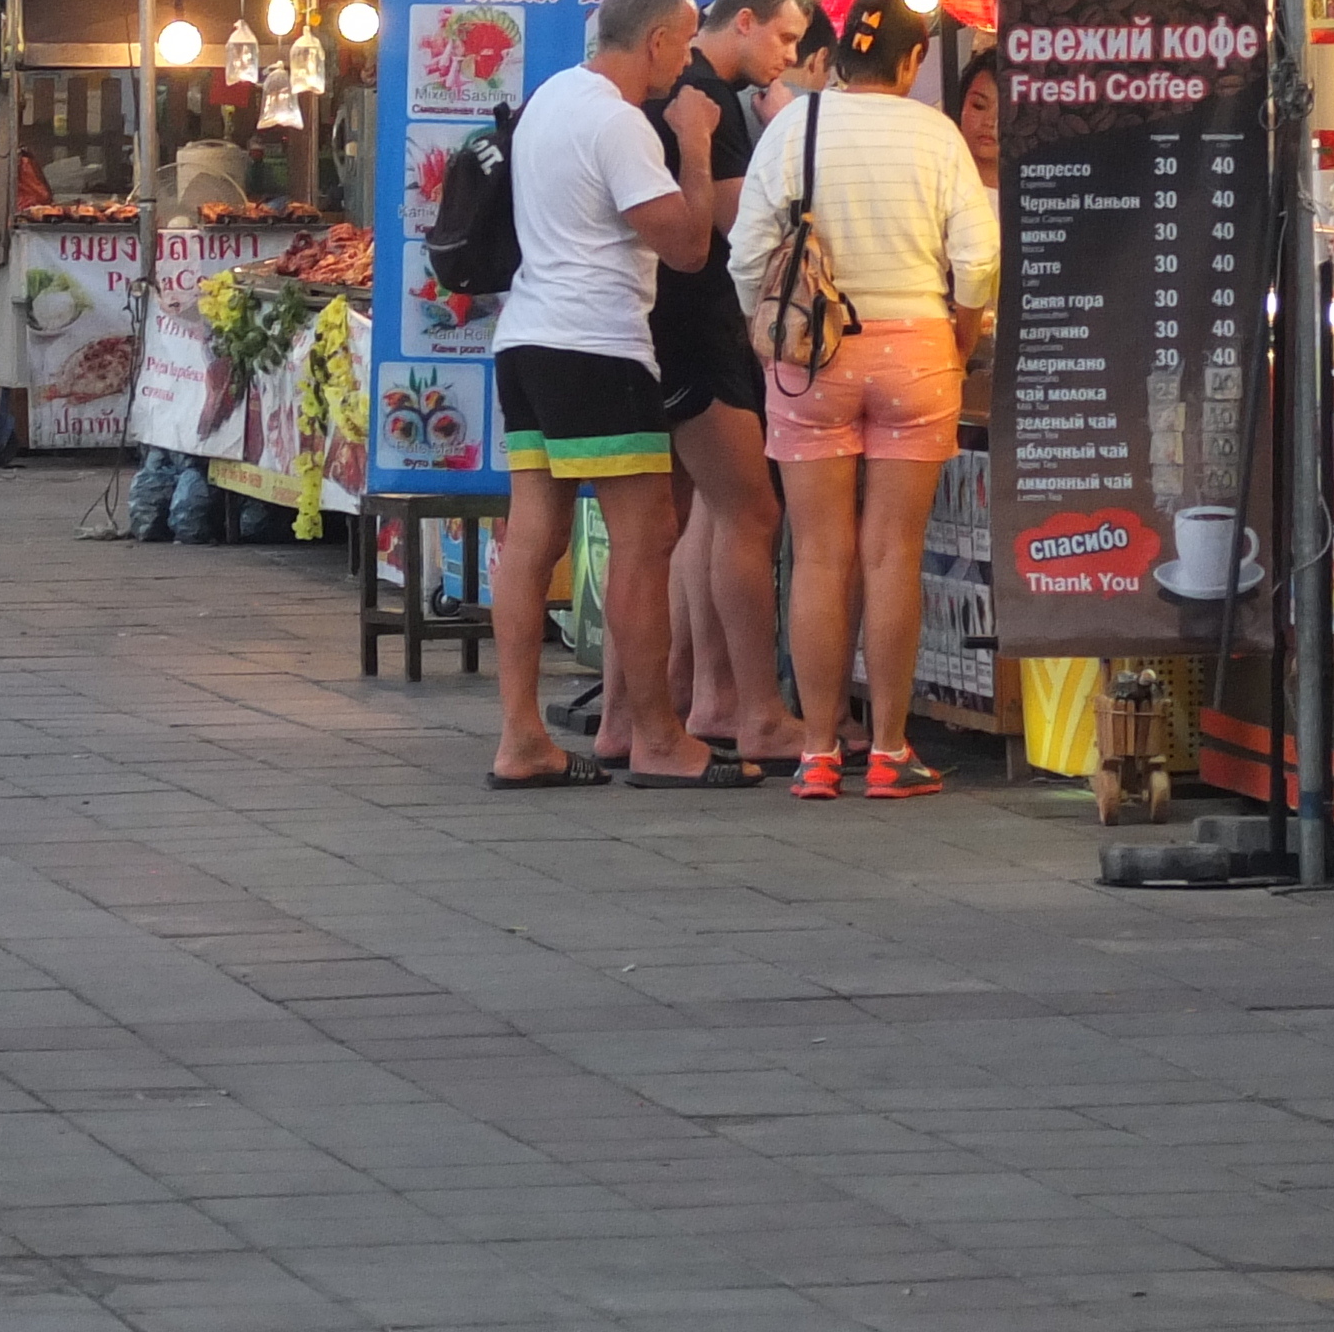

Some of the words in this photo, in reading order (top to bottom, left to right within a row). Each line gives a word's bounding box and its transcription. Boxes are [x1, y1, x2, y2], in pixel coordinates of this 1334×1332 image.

[1007, 16, 1152, 62] свежий
[1163, 16, 1259, 69] кофе
[461, 88, 517, 103] Sashimi
[1011, 74, 1097, 102] Fresh
[1106, 73, 1204, 101] Coffee
[1020, 164, 1091, 180] эспрессо
[1154, 157, 1178, 175] 30
[1212, 156, 1235, 174] 40
[1020, 194, 1080, 213] Черный
[1084, 193, 1141, 210] Каньон
[1154, 190, 1178, 209] 30
[1212, 190, 1235, 208] 40
[1021, 229, 1067, 243] мокко
[1154, 223, 1178, 241] 30
[1212, 222, 1235, 240] 40
[1021, 259, 1061, 275] Латте
[1154, 254, 1178, 273] 30
[1212, 254, 1235, 272] 40
[1068, 294, 1104, 311] гора
[1154, 289, 1178, 307] 30
[1212, 289, 1235, 307] 40
[1154, 320, 1178, 338] 30
[1212, 319, 1235, 337] 40
[1017, 356, 1106, 374] Американо
[1154, 348, 1178, 366] 30
[1212, 348, 1235, 366] 40
[1016, 386, 1044, 402] чай
[1048, 386, 1107, 401] молока
[1016, 413, 1085, 431] зеленый
[1087, 413, 1117, 430] чай
[1016, 443, 1096, 460] яблочный
[1099, 442, 1129, 459] чай
[1017, 474, 1100, 491] лимонный
[1103, 473, 1133, 490] чай
[1029, 522, 1129, 561] спасибо
[1025, 571, 1092, 592] Thank
[1098, 572, 1140, 591] You
